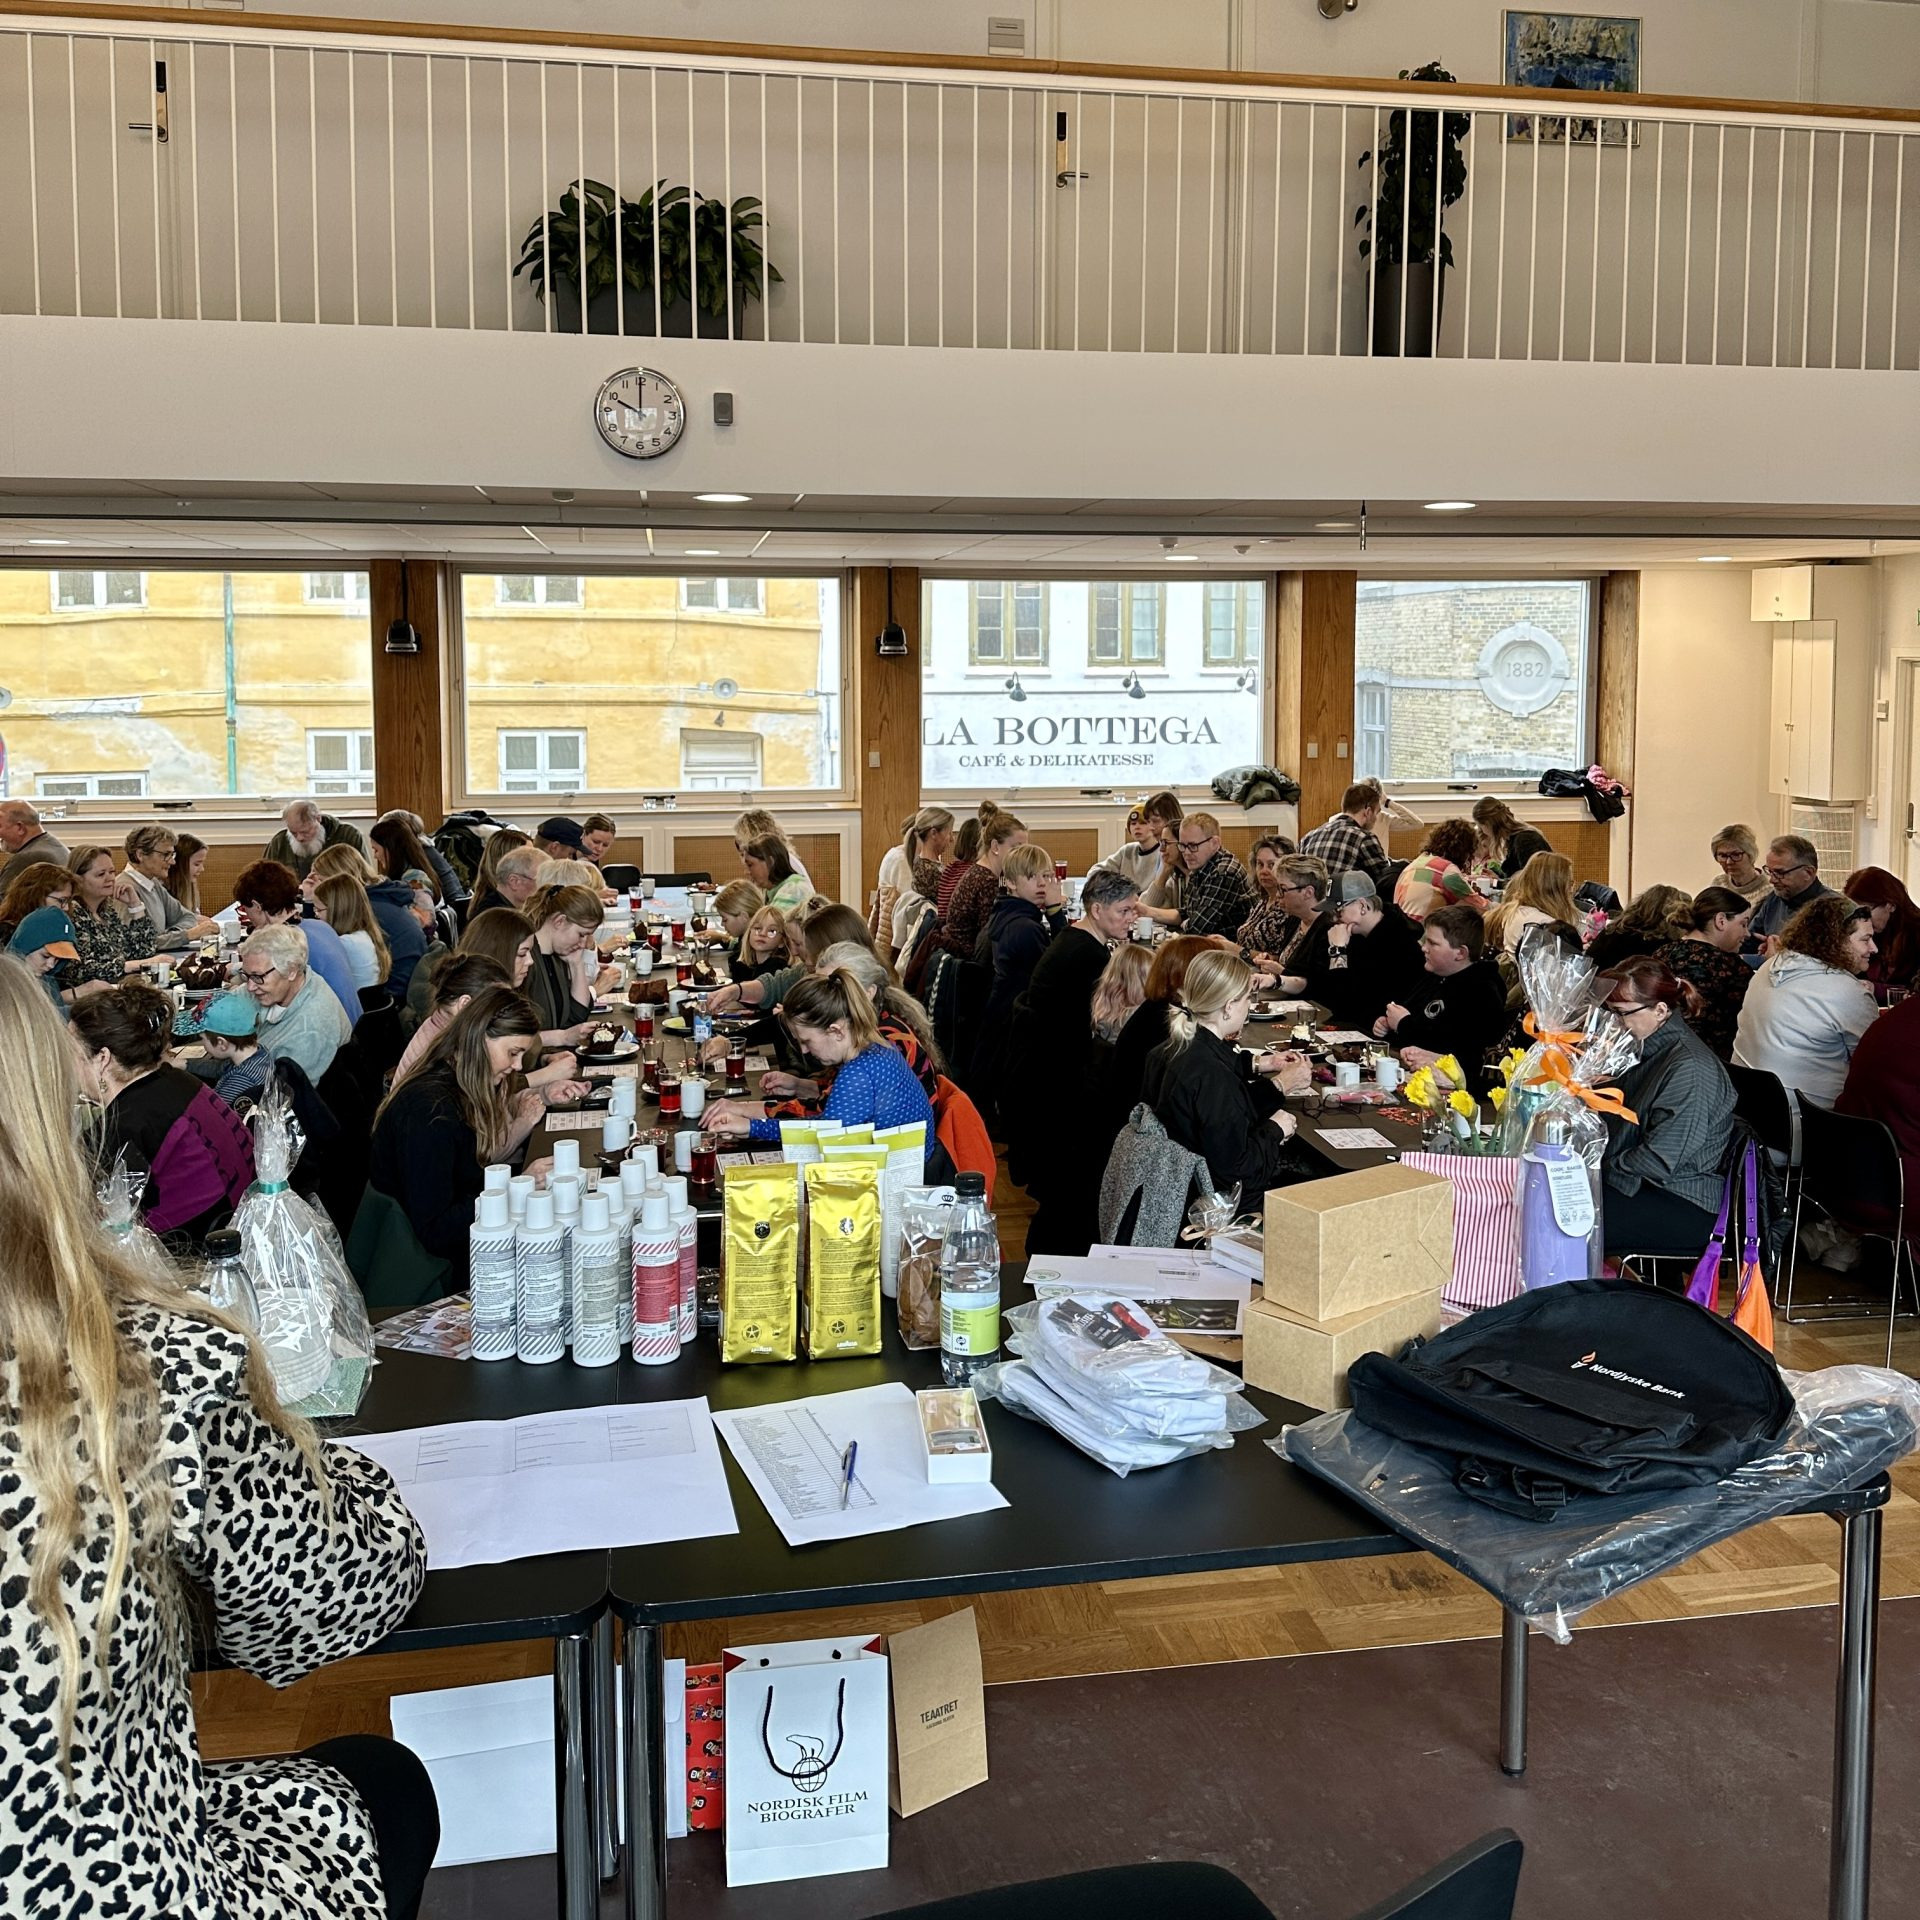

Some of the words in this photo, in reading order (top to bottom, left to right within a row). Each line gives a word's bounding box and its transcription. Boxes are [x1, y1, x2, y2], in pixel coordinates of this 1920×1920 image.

[622, 380, 629, 389] 11
[609, 392, 618, 401] 10
[663, 395, 672, 404] 2
[668, 411, 677, 420] 3
[608, 423, 617, 432] 8
[663, 427, 672, 436] 4
[620, 435, 628, 445] 7
[651, 438, 661, 447] 5
[635, 441, 644, 450] 6
[1505, 662, 1544, 678] 1882
[922, 716, 978, 746] LA
[993, 716, 1222, 746] BOTTEGA
[958, 753, 1006, 767] CAFÉ
[1010, 755, 1025, 767] &
[1029, 754, 1154, 767] DELIKATESSE
[1588, 1363, 1652, 1388] Nordjyske
[1650, 1384, 1686, 1399] Bank
[920, 1699, 959, 1724] TEAATRET
[747, 1796, 825, 1814] NORDISK
[829, 1790, 868, 1805] FILM
[760, 1803, 856, 1823] BIOGRAFER
